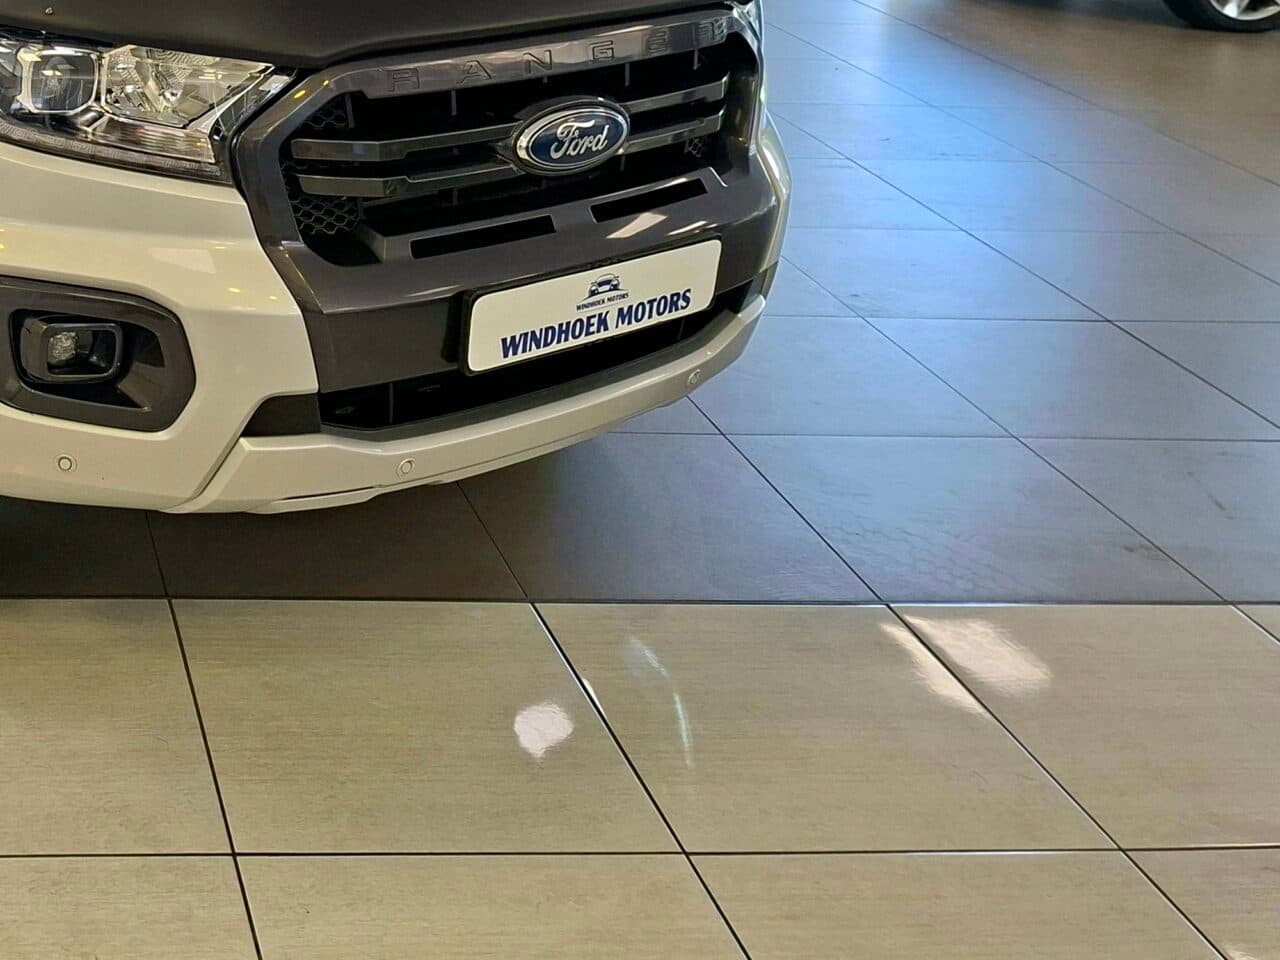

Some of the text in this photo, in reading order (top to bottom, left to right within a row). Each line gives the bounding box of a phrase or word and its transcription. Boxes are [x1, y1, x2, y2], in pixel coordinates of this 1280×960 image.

[387, 21, 714, 93] RANGER
[550, 119, 610, 160] Ford
[501, 288, 692, 359] WINDHOEK MOTORS
